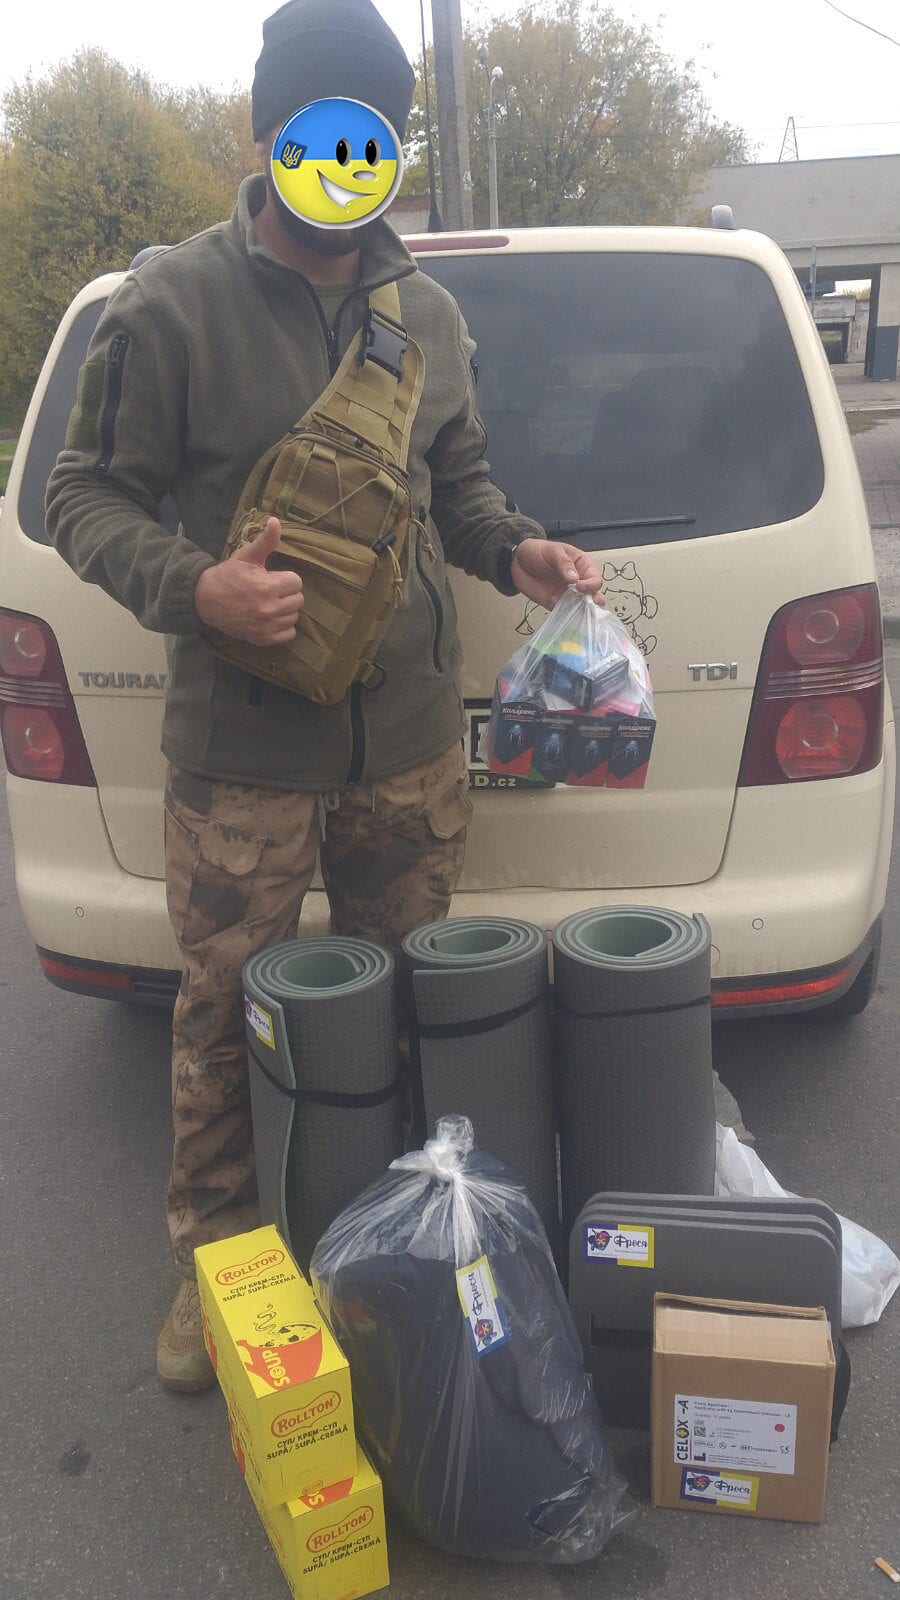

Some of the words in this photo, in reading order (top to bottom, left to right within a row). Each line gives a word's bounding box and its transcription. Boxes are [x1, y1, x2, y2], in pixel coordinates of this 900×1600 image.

[687, 662, 738, 681] TDI
[613, 1233, 648, 1249] Фреся
[222, 1254, 278, 1283] ROLLTON
[248, 1273, 285, 1289] КРЕМ-СУП
[468, 1272, 484, 1316] Фреся
[277, 1398, 334, 1433] ROLLTON
[297, 1421, 338, 1441] КРЕМ-СУП
[676, 1419, 690, 1461] CELOX
[713, 1480, 751, 1494] Фреся
[312, 1512, 368, 1549] ROLLTON
[332, 1534, 371, 1555] КРЕМ-СУП
